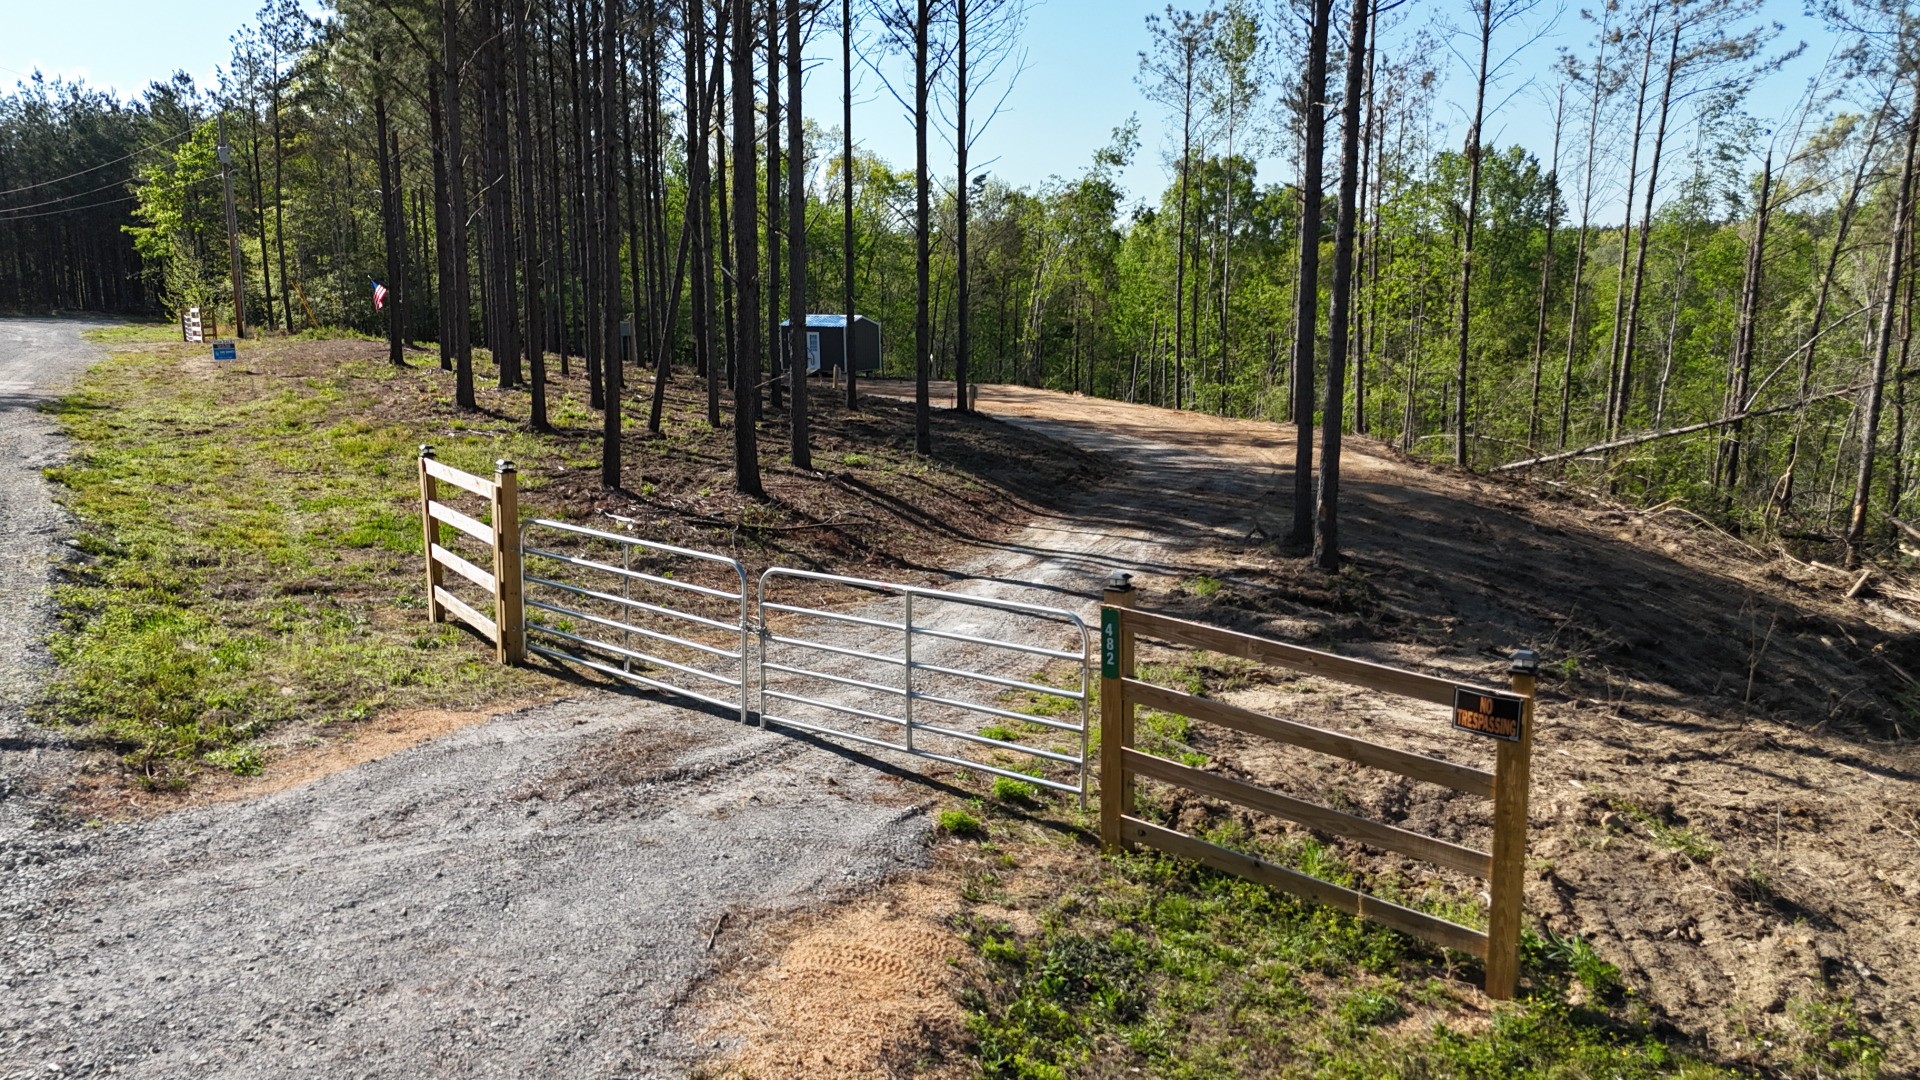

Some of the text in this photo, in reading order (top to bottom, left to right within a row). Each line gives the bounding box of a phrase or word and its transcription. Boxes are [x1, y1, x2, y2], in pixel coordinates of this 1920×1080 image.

[1105, 623, 1114, 665] 482
[1480, 696, 1493, 715] NO
[1457, 708, 1516, 736] TRESPASSING
